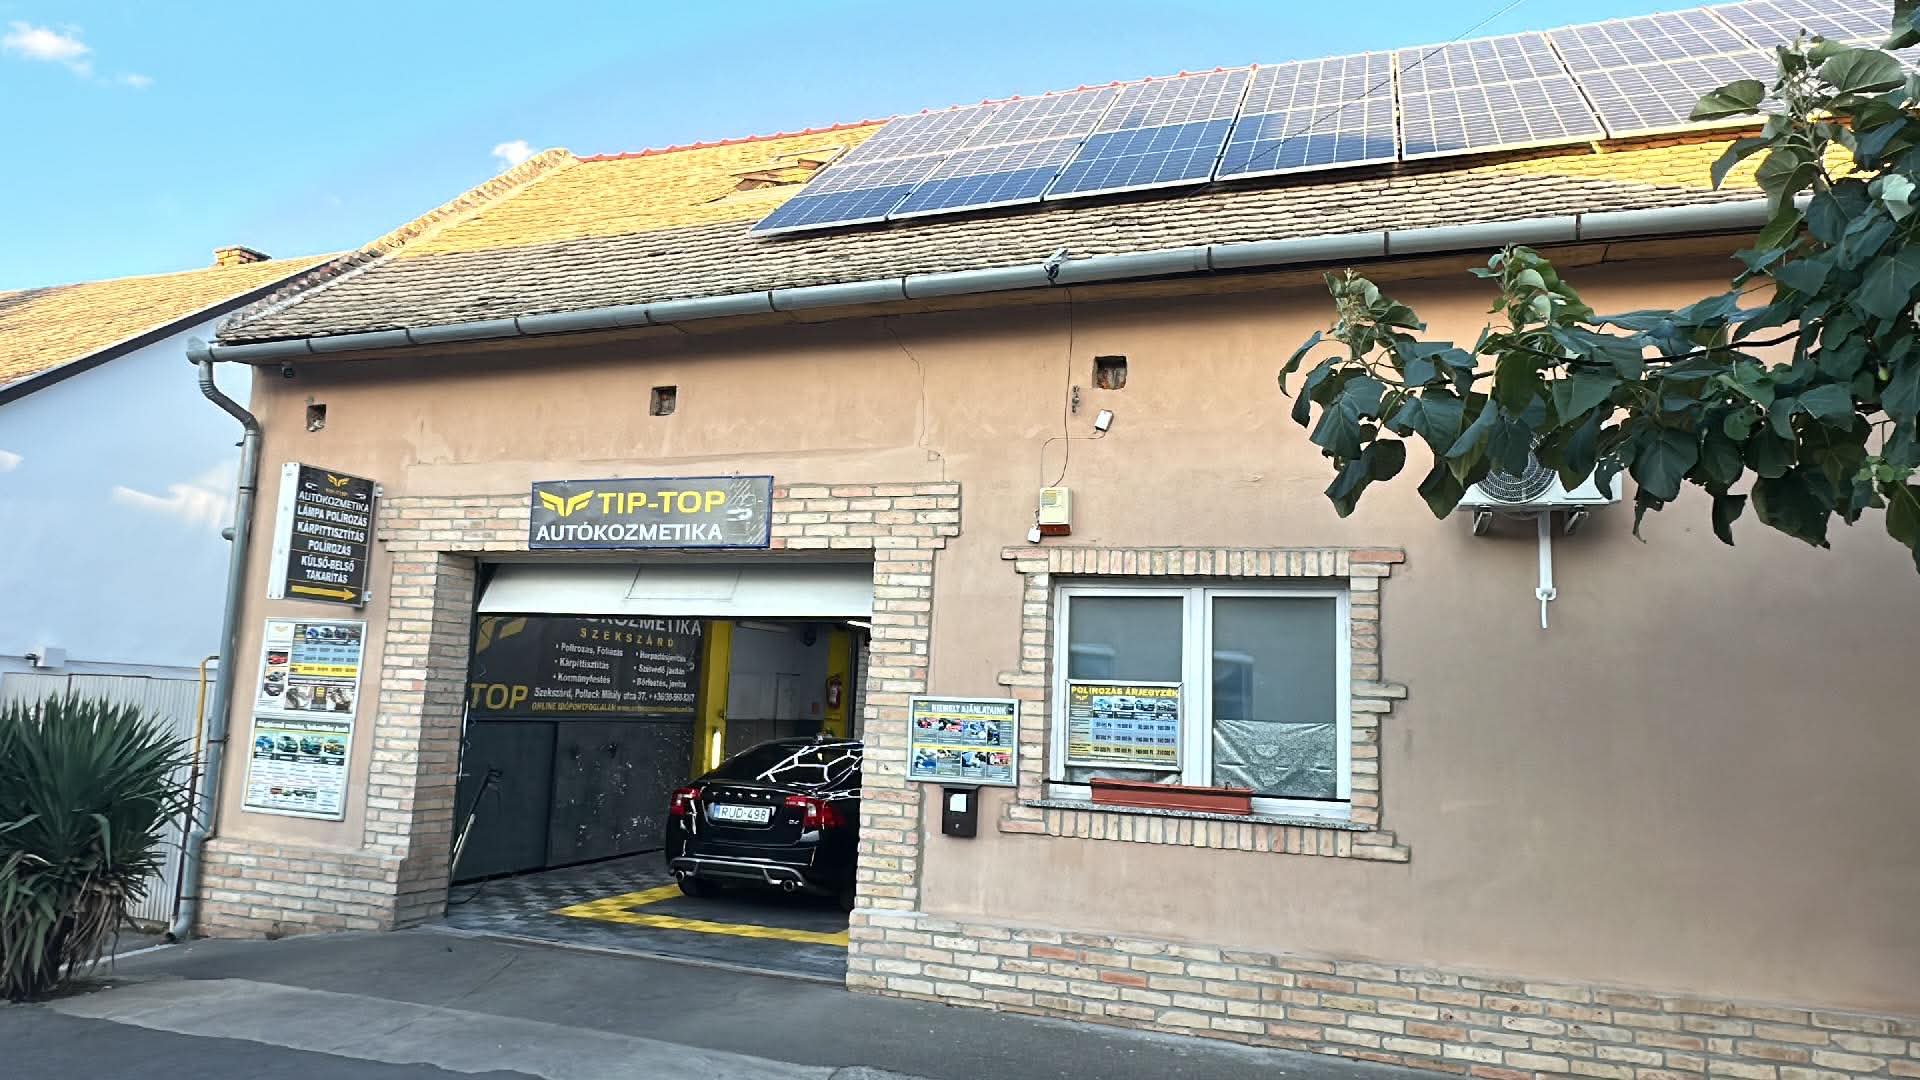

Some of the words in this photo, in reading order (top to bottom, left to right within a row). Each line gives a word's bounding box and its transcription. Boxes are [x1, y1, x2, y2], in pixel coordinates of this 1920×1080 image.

[298, 503, 324, 519] LÁMPA
[598, 490, 726, 514] TIP-TOP
[536, 521, 723, 541] AUTÓKOZMETIKA
[721, 807, 767, 820] RUD-498
